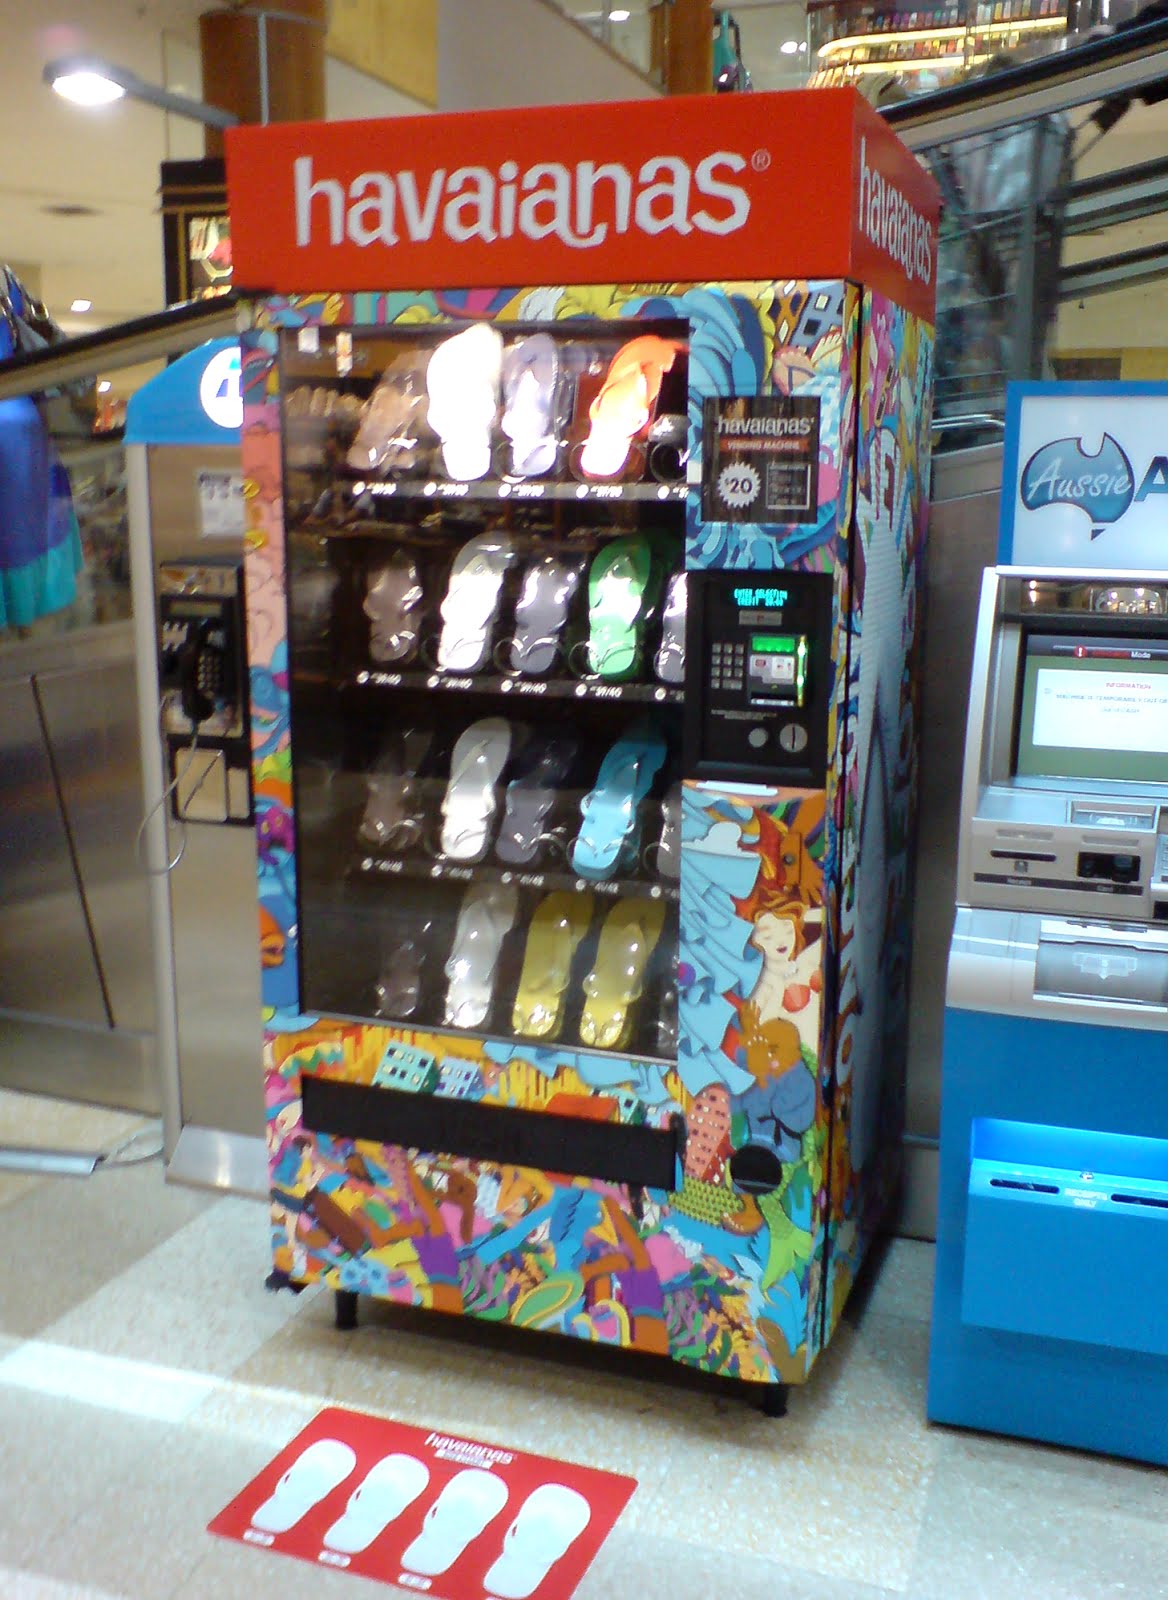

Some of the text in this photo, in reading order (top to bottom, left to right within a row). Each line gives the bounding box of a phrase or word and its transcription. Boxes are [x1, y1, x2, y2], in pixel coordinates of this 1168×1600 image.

[294, 152, 752, 249] havaianas
[858, 136, 932, 285] havaianas
[717, 415, 811, 437] havaianas
[1027, 456, 1132, 501] Aussie
[1130, 650, 1151, 659] Mode
[1105, 681, 1152, 690] INFORMATION
[424, 1432, 513, 1465] havaianas
